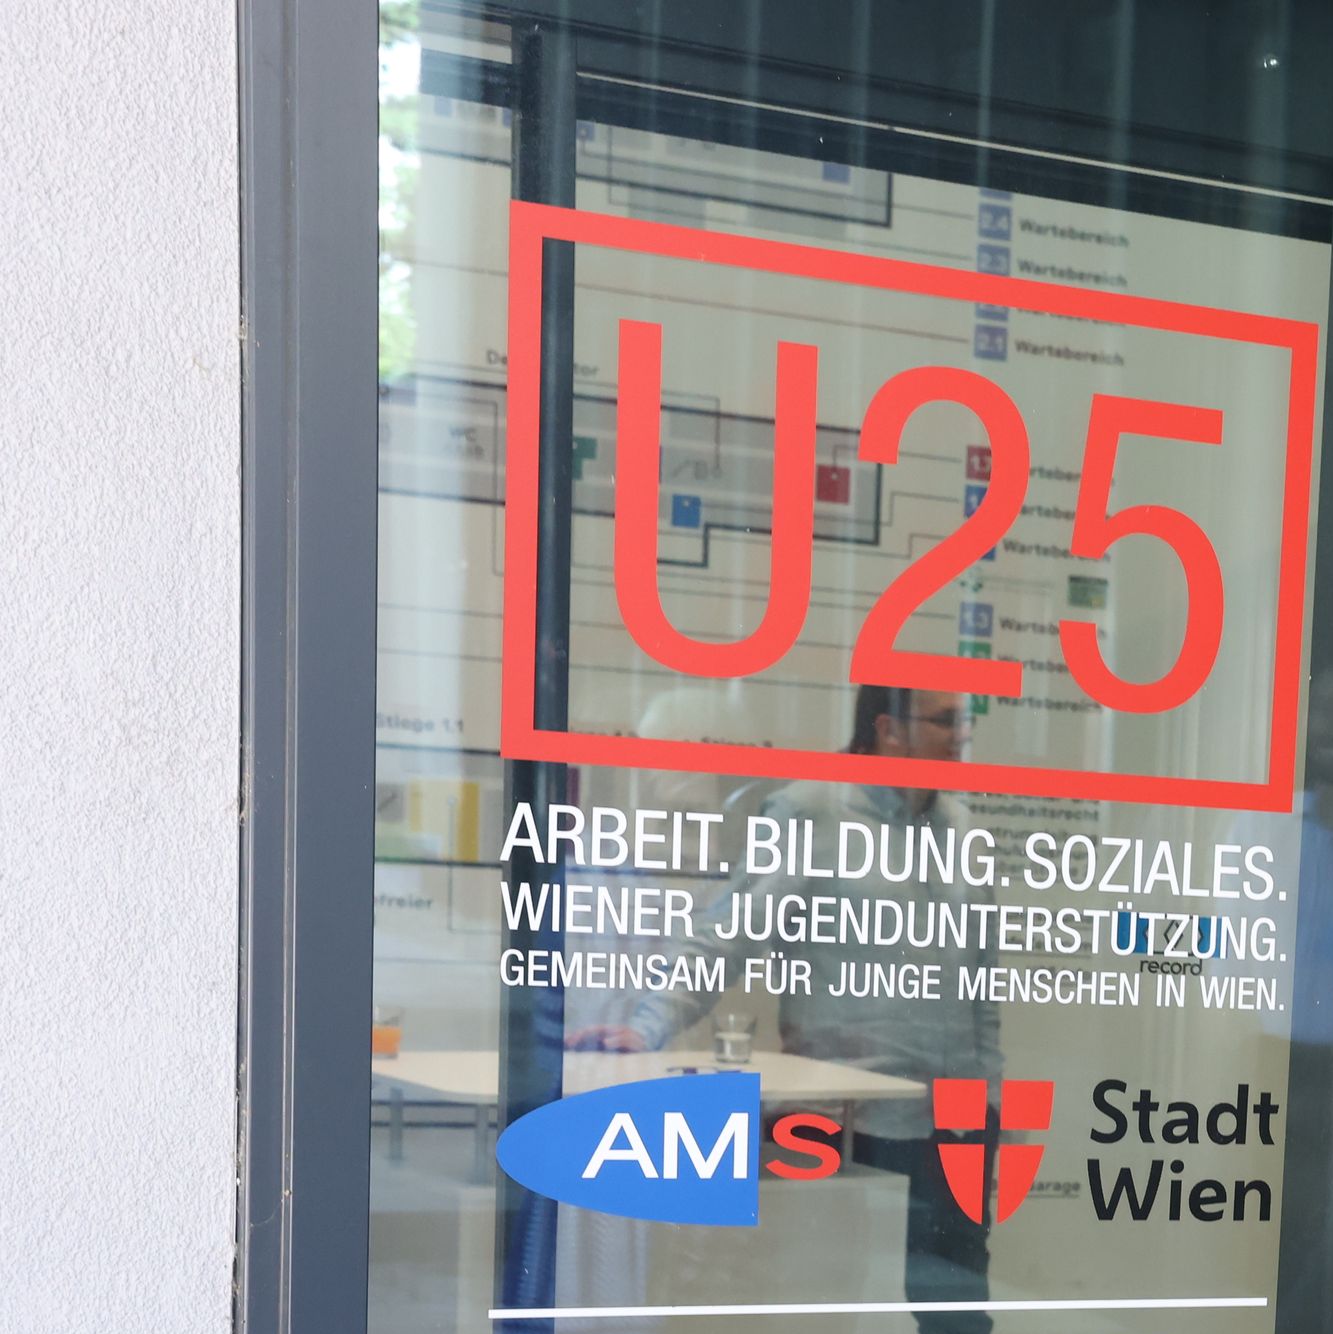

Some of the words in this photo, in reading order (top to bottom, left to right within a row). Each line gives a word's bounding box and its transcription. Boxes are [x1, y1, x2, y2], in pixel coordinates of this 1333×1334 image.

[614, 319, 1225, 715] U25
[499, 802, 729, 873] ARBEIT.
[746, 816, 1010, 887] BILDUNG.
[1024, 832, 1287, 901] SOZIALES.
[500, 881, 694, 938] WIENER
[714, 892, 1287, 962] JUGENDUNTERSTÜTZUNG.
[500, 949, 725, 992] GEMEINSAM
[744, 952, 812, 995] FÜR
[828, 961, 941, 1000] JUNGE
[958, 966, 1140, 1006] MENSCHEN
[1156, 974, 1186, 1008] IN
[1199, 975, 1285, 1011] WIEN.
[1139, 958, 1203, 977] record
[582, 1112, 842, 1181] AMS
[1090, 1079, 1281, 1146] Stadt
[1087, 1158, 1272, 1222] Wien
